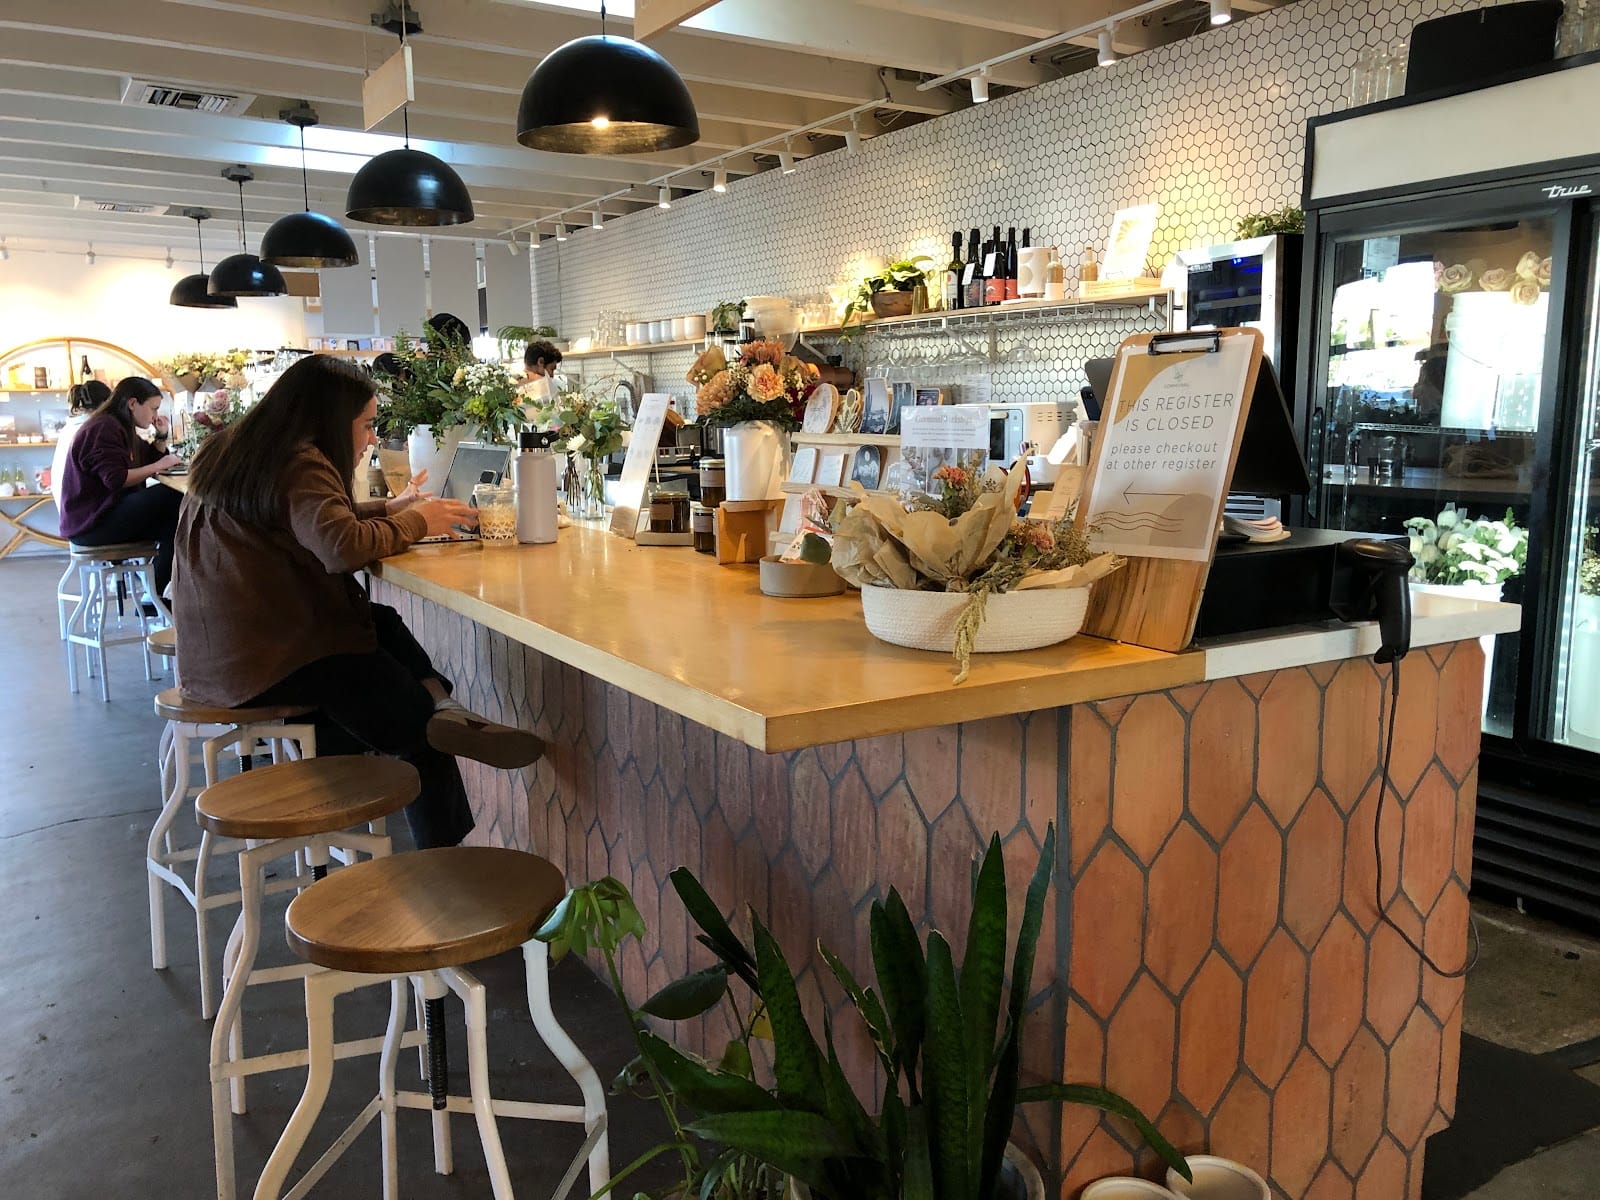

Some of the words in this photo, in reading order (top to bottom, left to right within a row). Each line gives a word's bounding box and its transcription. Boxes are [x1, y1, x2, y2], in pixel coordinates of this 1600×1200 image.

[1541, 184, 1592, 198] true
[1119, 398, 1150, 413] THIS
[1156, 393, 1234, 411] REGISTER
[1125, 419, 1140, 432] IS
[1146, 415, 1214, 431] CLOSED
[1111, 443, 1151, 456] please
[1156, 441, 1218, 454] checkout
[1106, 460, 1119, 470] at
[1123, 458, 1157, 470] other
[1161, 459, 1217, 472] register
